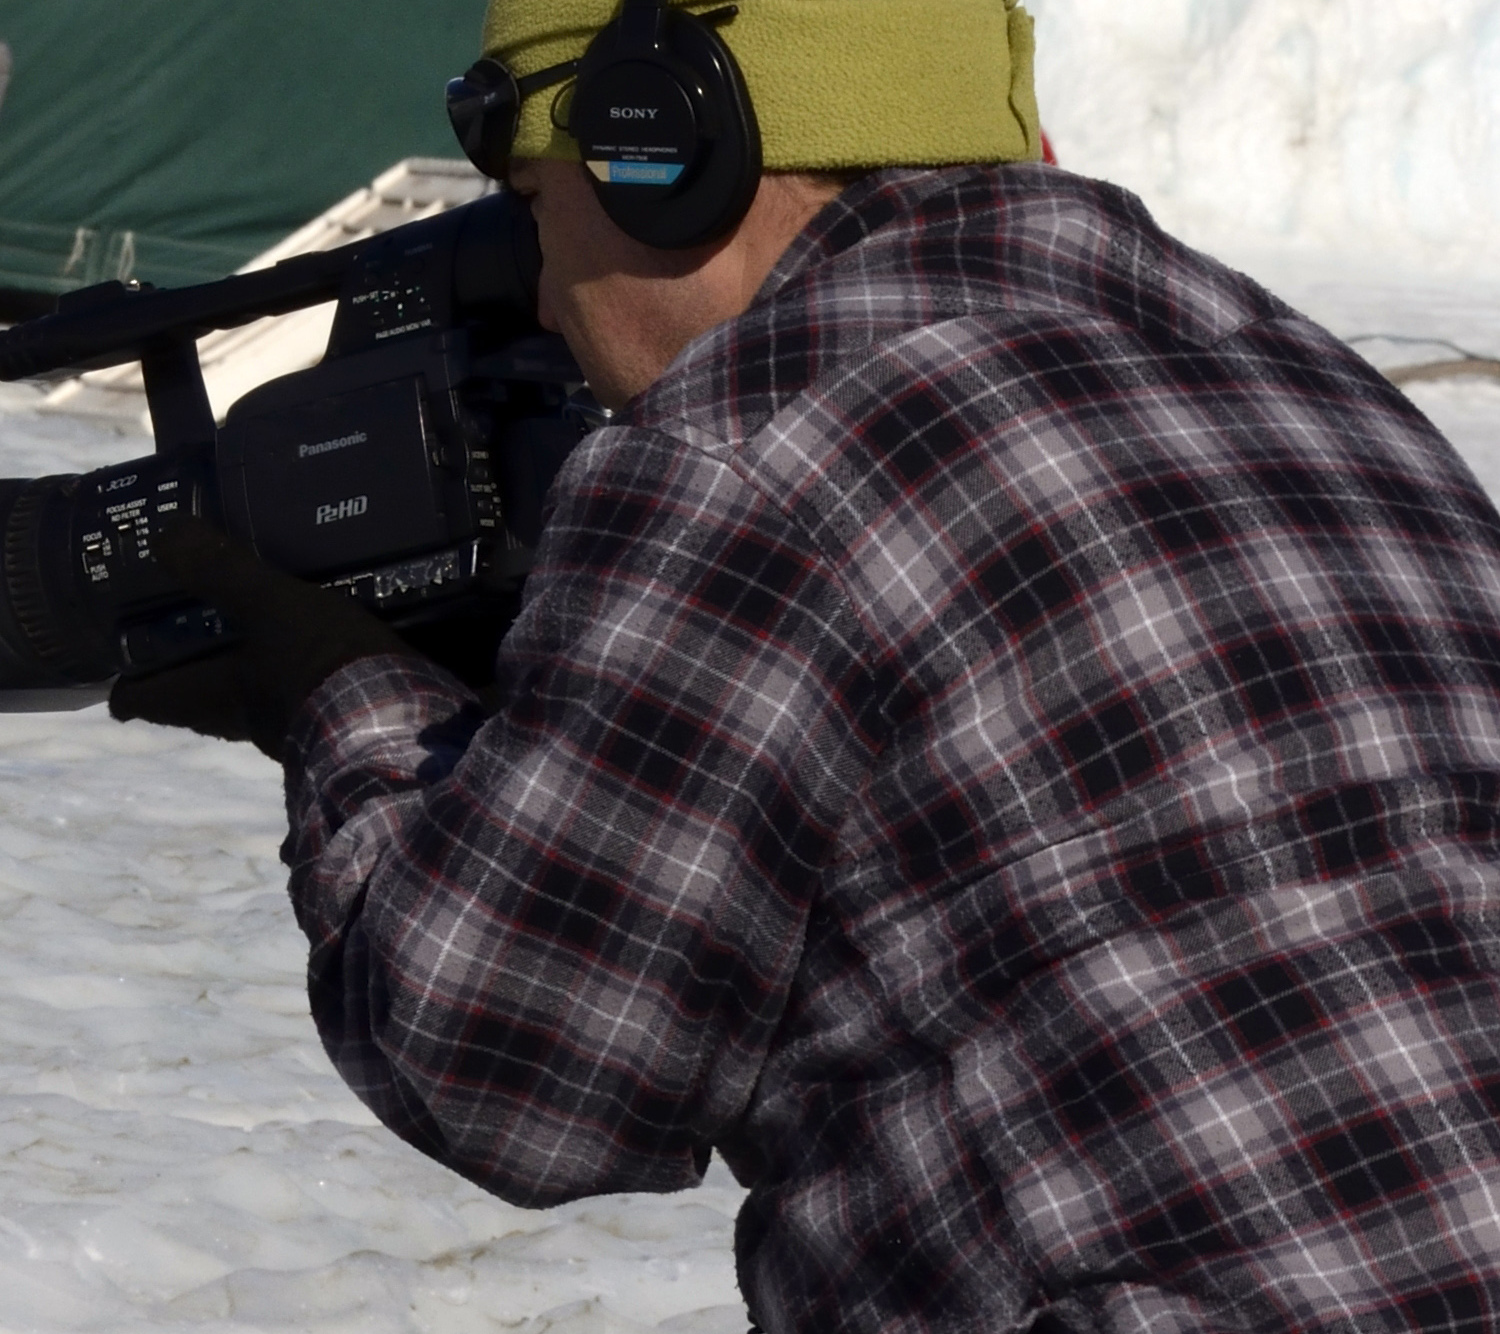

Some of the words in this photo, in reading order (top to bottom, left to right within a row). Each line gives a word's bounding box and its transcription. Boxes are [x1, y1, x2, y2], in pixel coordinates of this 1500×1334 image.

[609, 107, 659, 119] SONY
[640, 146, 678, 154] HEADPHONES
[299, 430, 368, 458] Panasonic
[106, 474, 138, 492] 3CCD
[157, 481, 178, 492] USER1
[106, 503, 126, 515] FOCUS
[126, 497, 148, 511] ASSIST
[157, 501, 178, 513] USER2
[121, 508, 141, 521] FILTER
[82, 531, 103, 543] FOCUS
[138, 549, 150, 559] OFF
[89, 563, 107, 574] PUSH
[91, 571, 109, 582] AUTO
